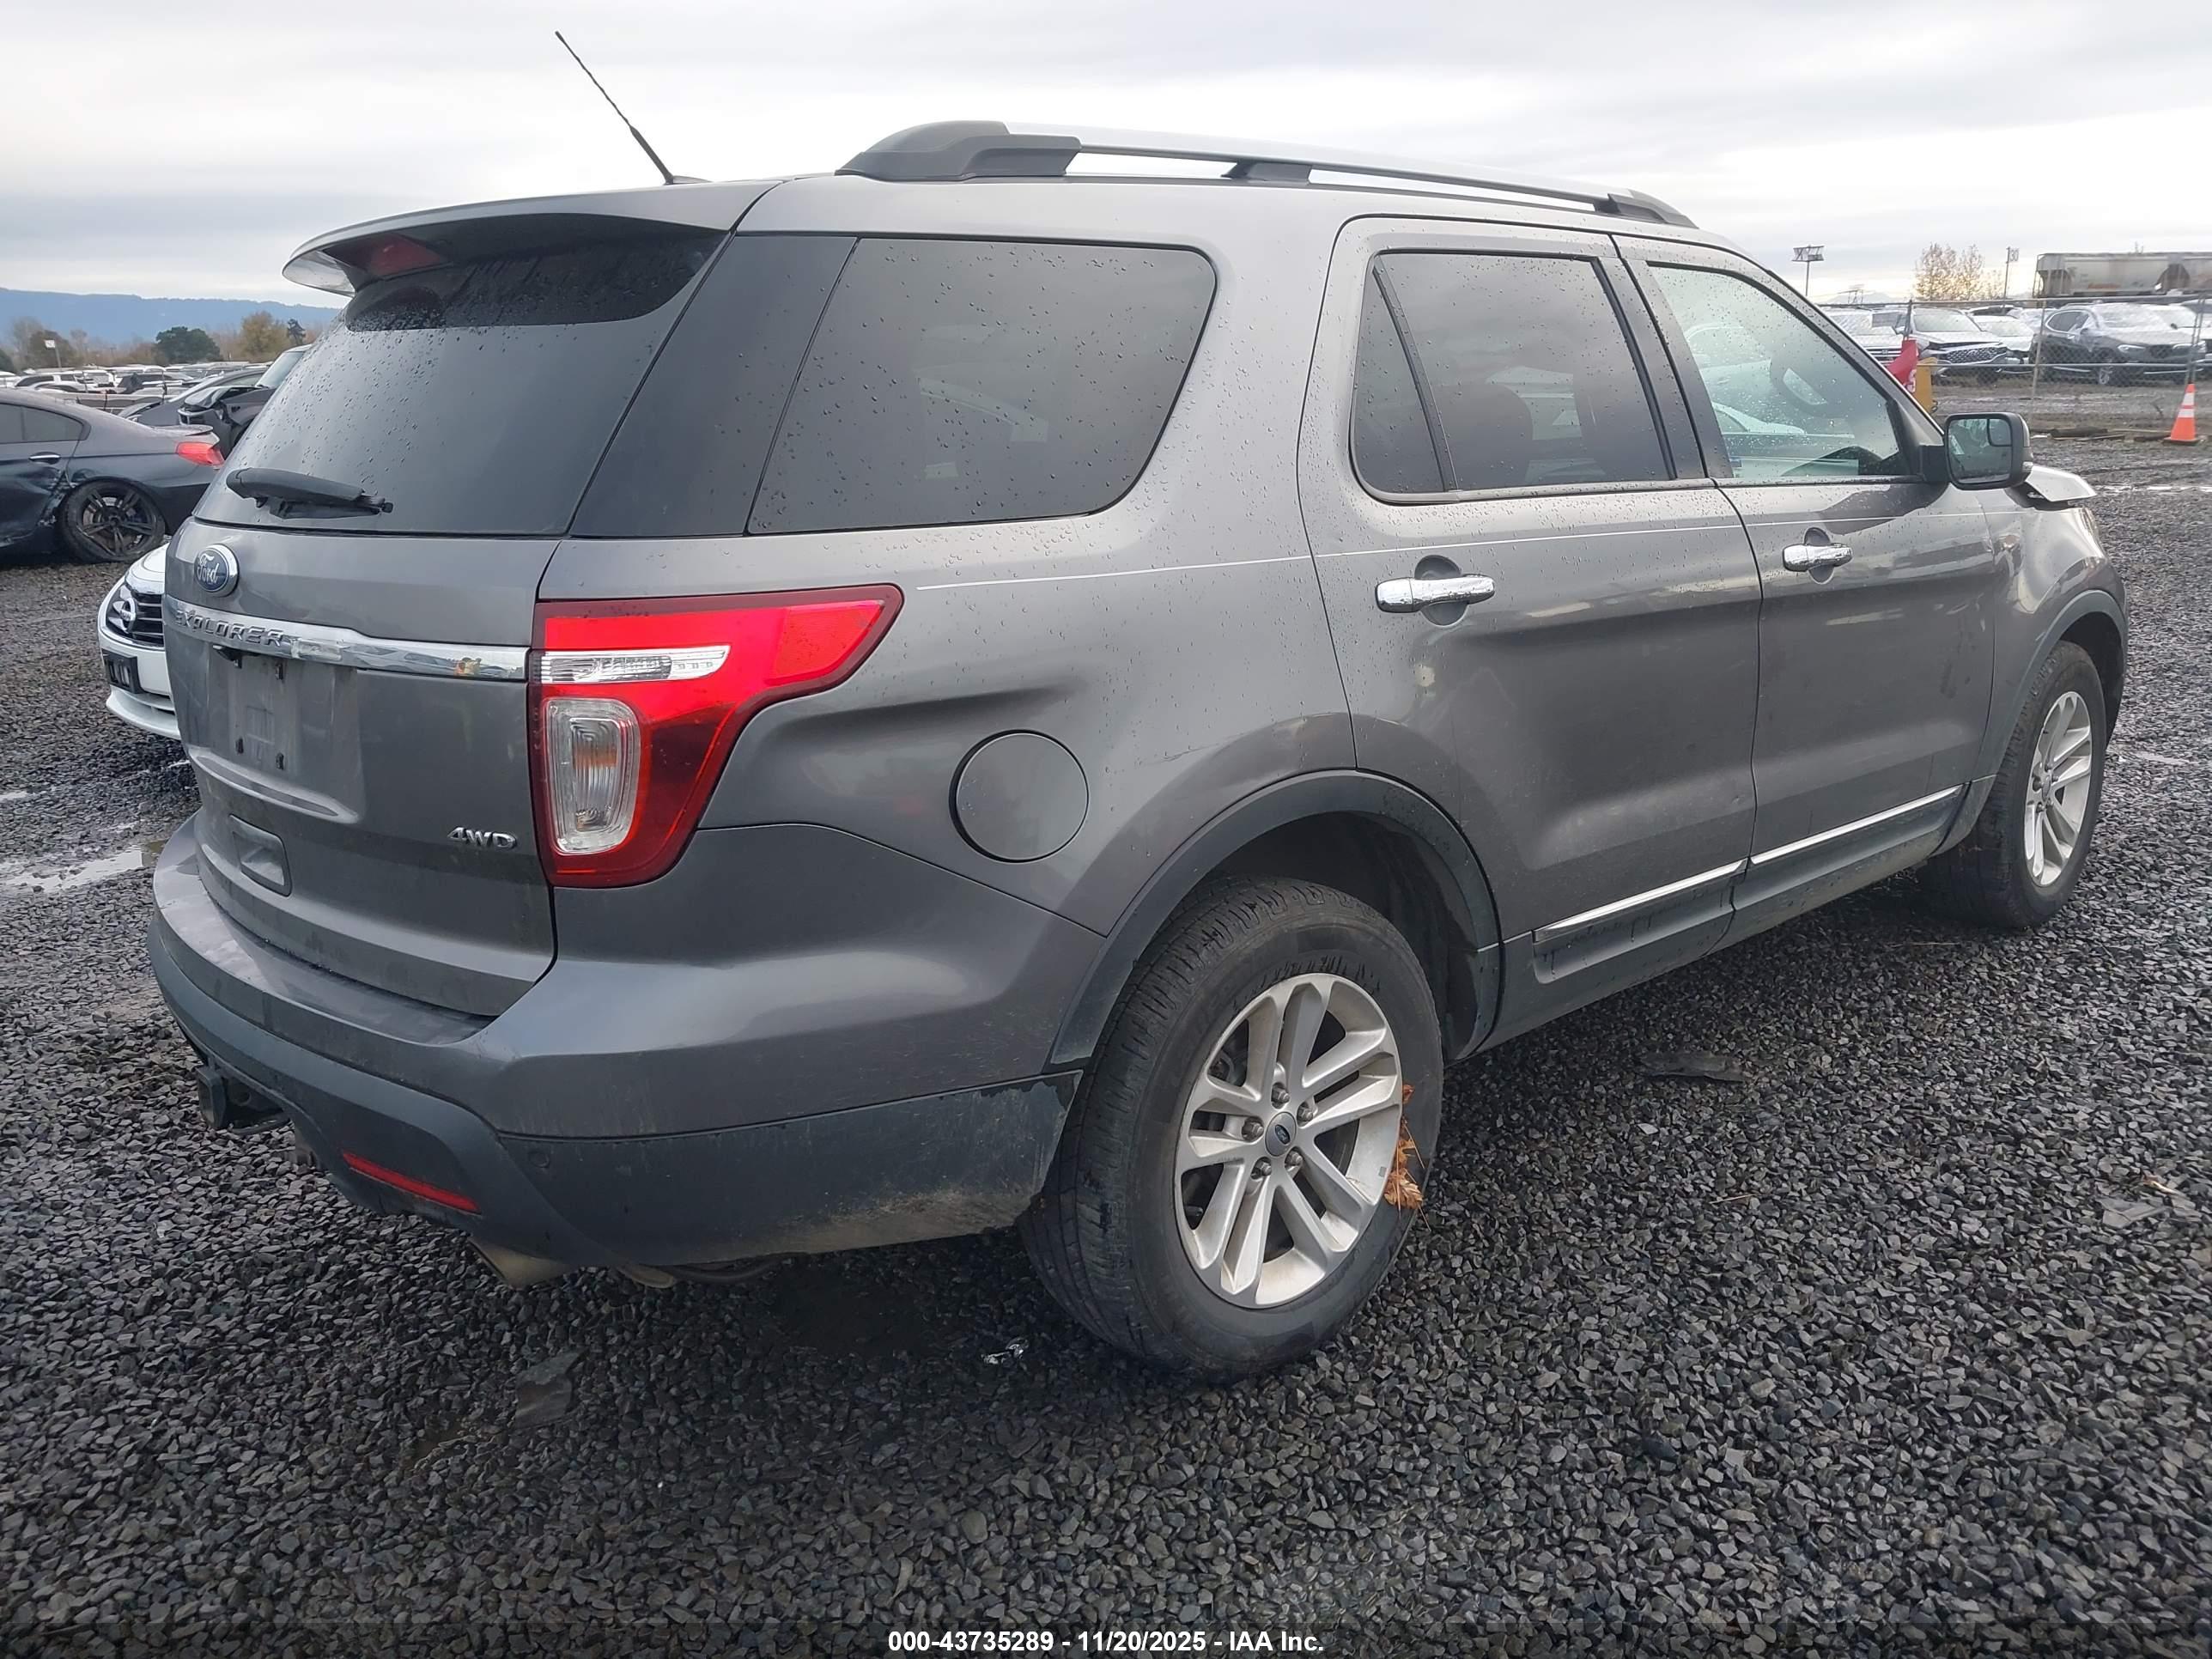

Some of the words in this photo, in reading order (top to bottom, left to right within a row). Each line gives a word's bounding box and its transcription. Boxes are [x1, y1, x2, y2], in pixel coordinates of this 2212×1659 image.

[196, 552, 221, 585] Ford
[174, 609, 283, 647] EXPLORER
[447, 825, 517, 849] 4WD
